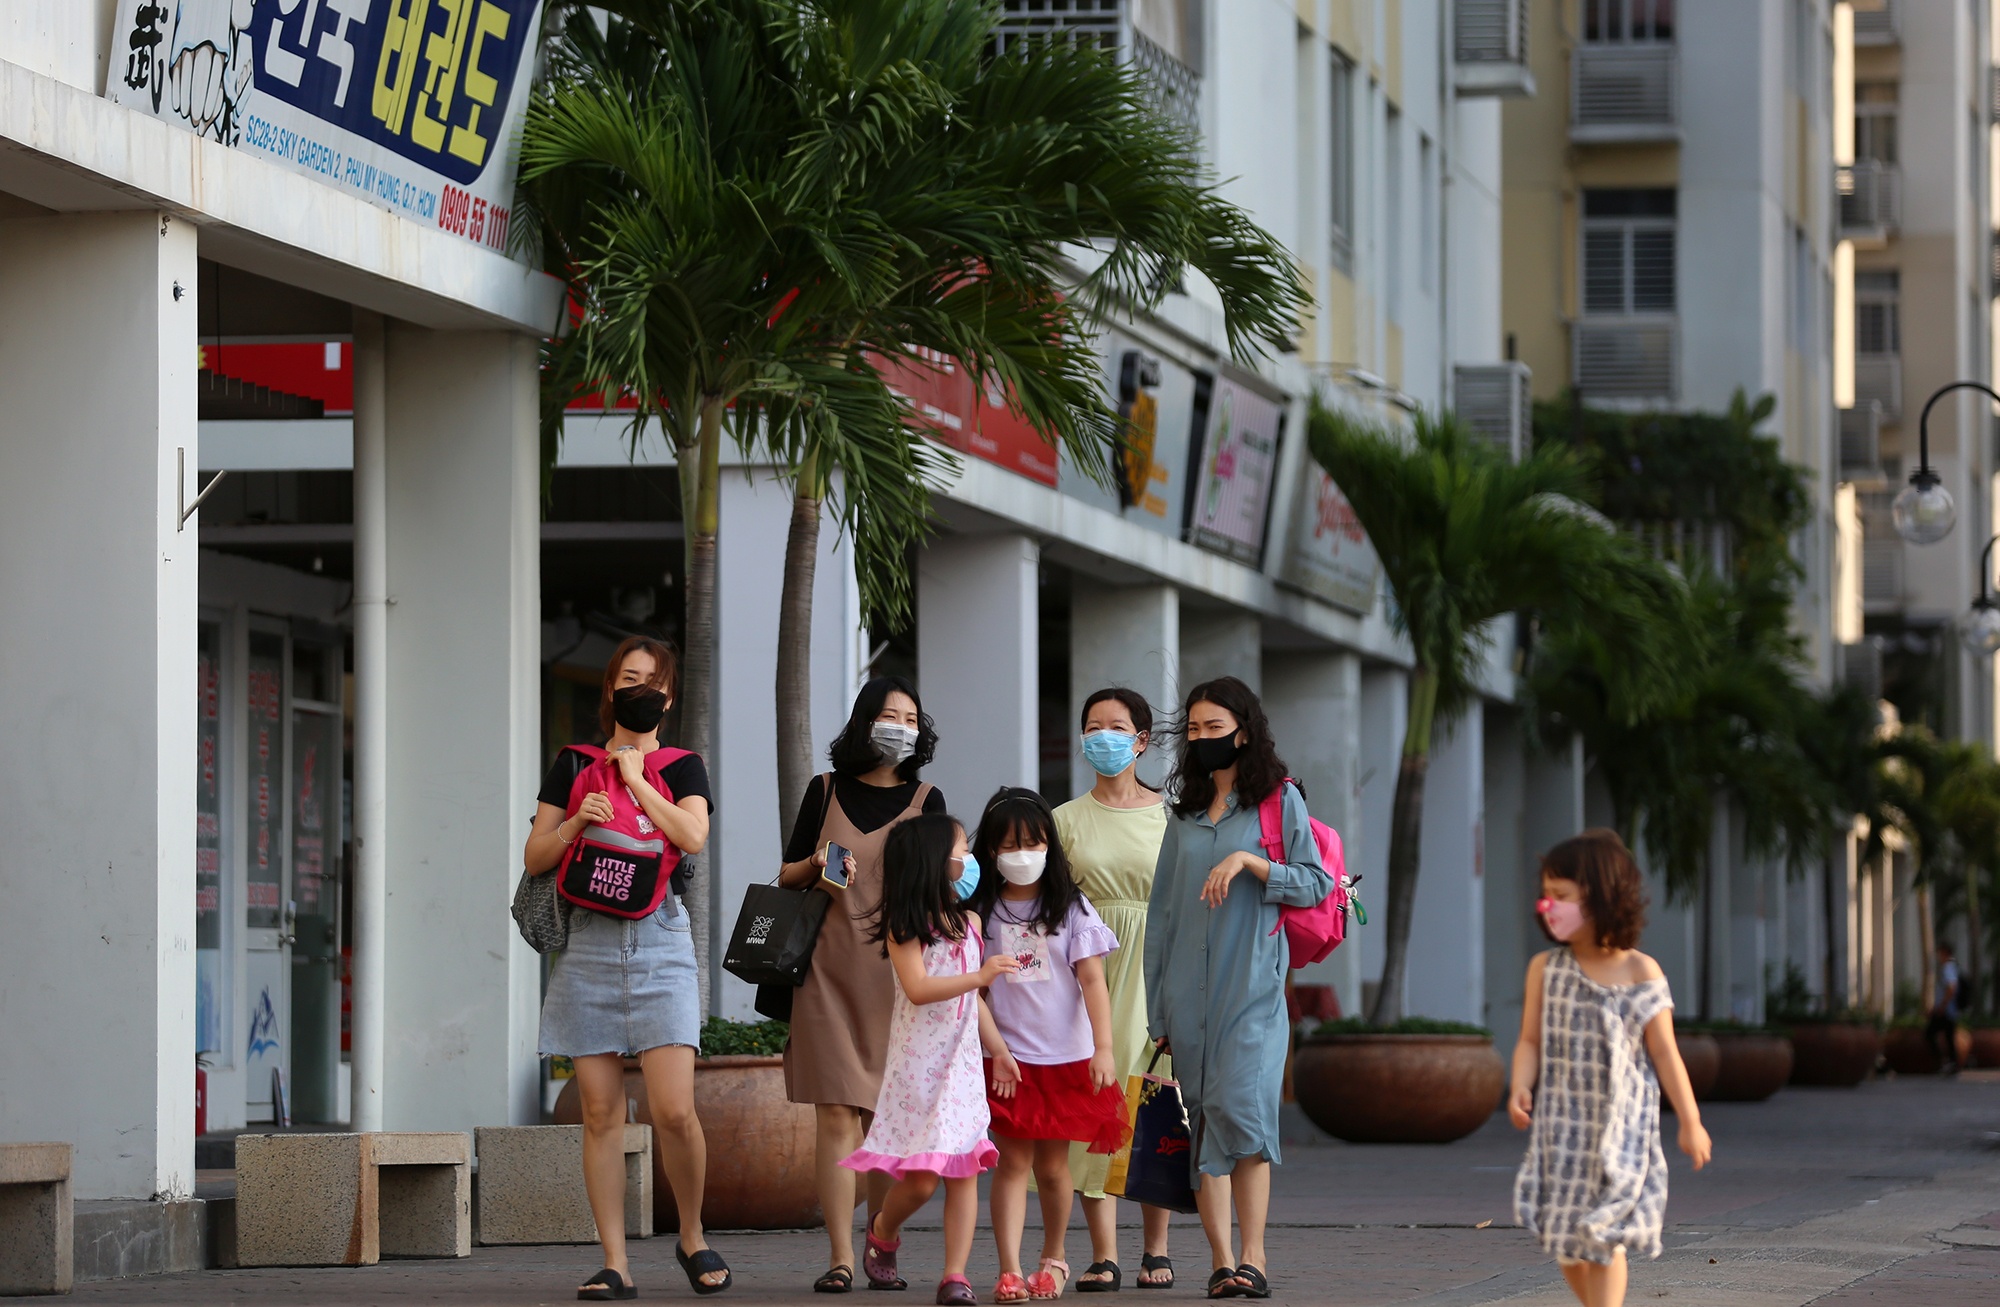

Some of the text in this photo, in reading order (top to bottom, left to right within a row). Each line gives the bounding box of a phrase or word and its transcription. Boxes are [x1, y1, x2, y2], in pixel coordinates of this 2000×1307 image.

[246, 115, 278, 152] SC28-2
[278, 128, 299, 160] SKY
[297, 137, 335, 177] GARDEN
[344, 157, 365, 188] PHU
[363, 163, 378, 193] MY
[417, 188, 437, 219] HCM
[438, 184, 510, 251] 0909 55 1111
[594, 857, 636, 875] LITTLE
[592, 867, 633, 888] MISS
[589, 880, 630, 902] HUG
